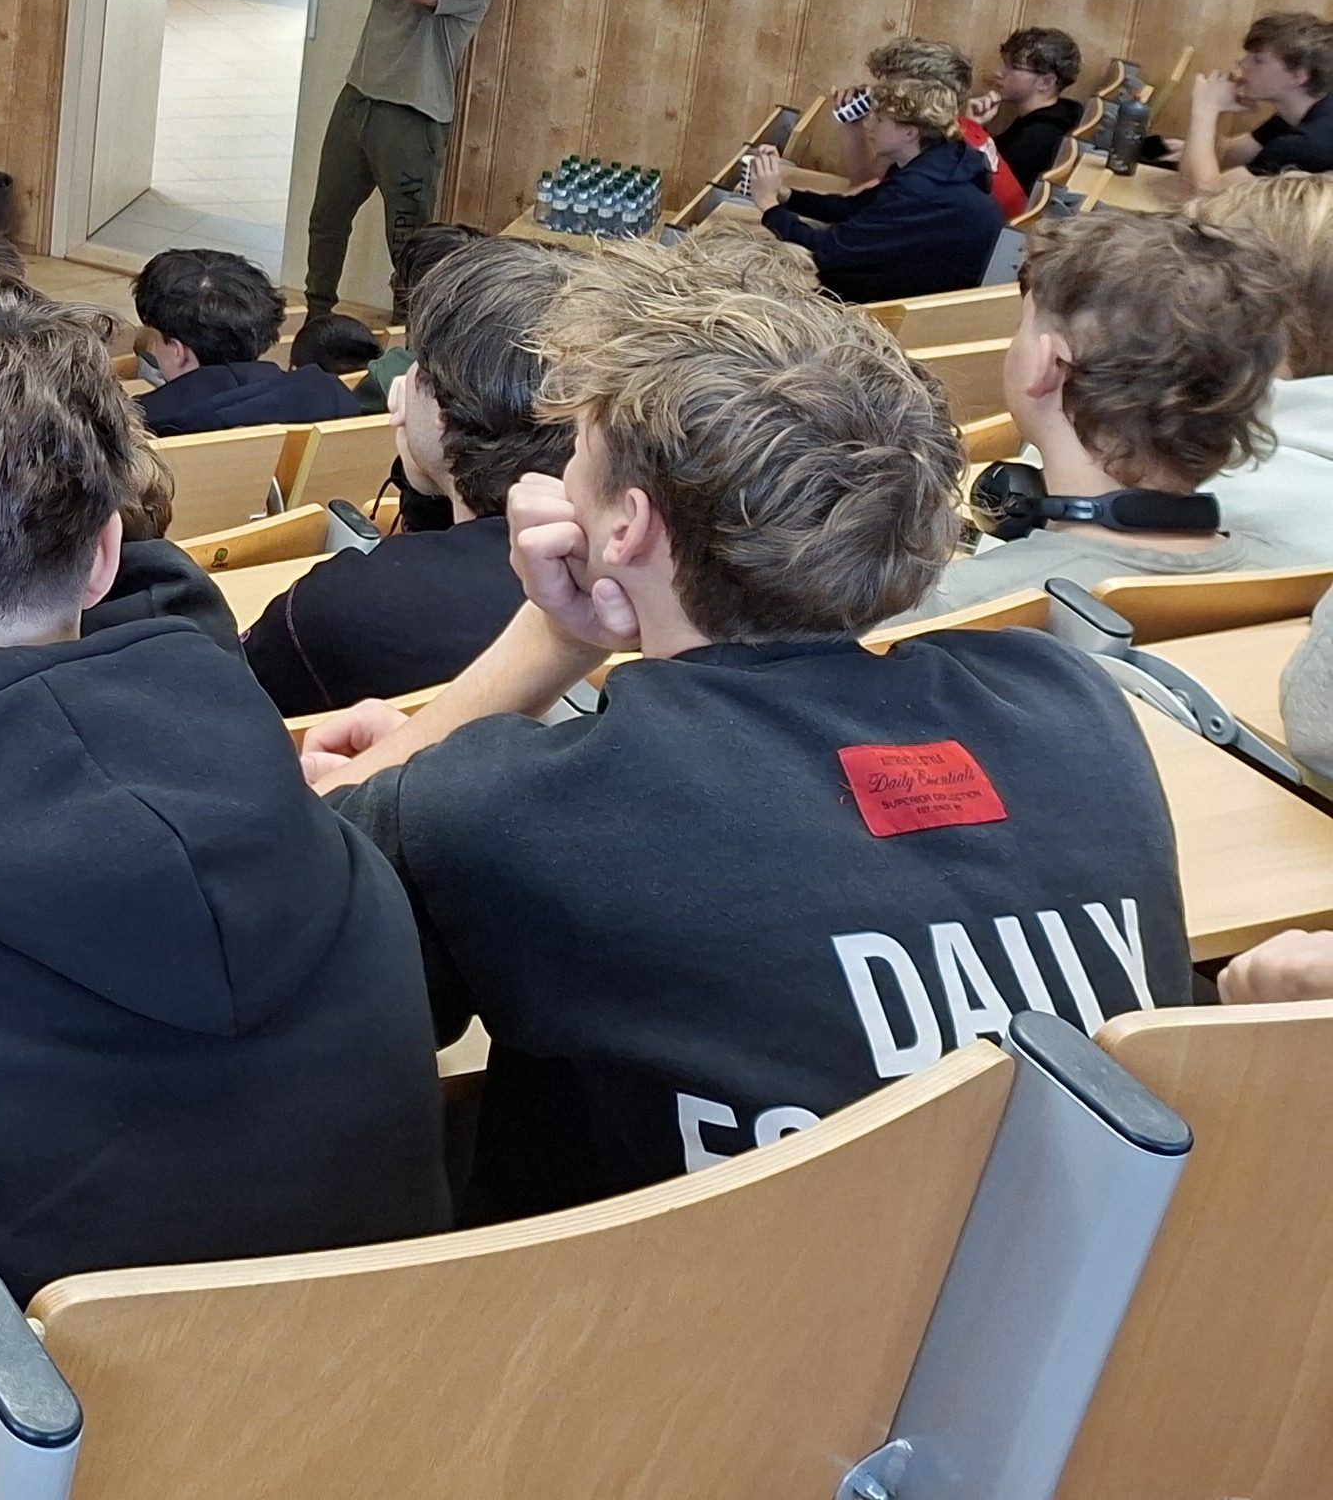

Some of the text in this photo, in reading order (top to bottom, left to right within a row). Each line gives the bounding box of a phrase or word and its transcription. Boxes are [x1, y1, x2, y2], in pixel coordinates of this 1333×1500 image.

[392, 171, 423, 255] EPLAY
[868, 770, 915, 793] Daily
[932, 790, 983, 802] COECTION
[831, 898, 1155, 1078] DAILY
